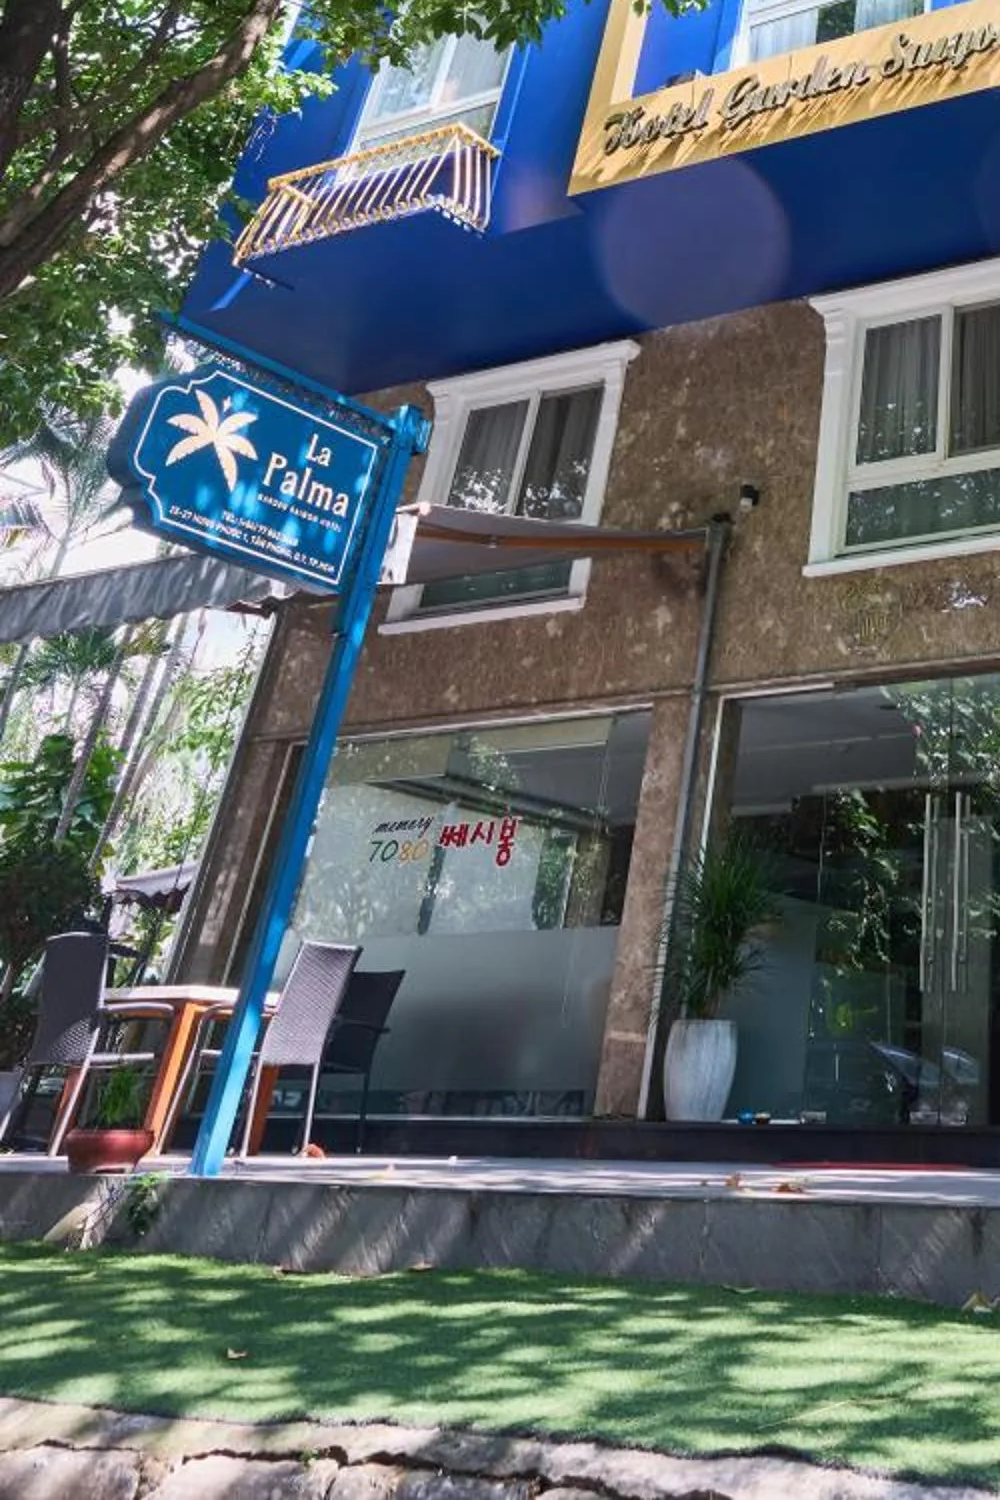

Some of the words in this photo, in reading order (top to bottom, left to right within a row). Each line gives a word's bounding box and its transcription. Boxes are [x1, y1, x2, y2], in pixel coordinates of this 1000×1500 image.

[604, 88, 709, 156] Hotel
[720, 55, 871, 130] Garden
[306, 432, 332, 467] La
[262, 452, 349, 518] Palma
[369, 839, 430, 863] 7080
